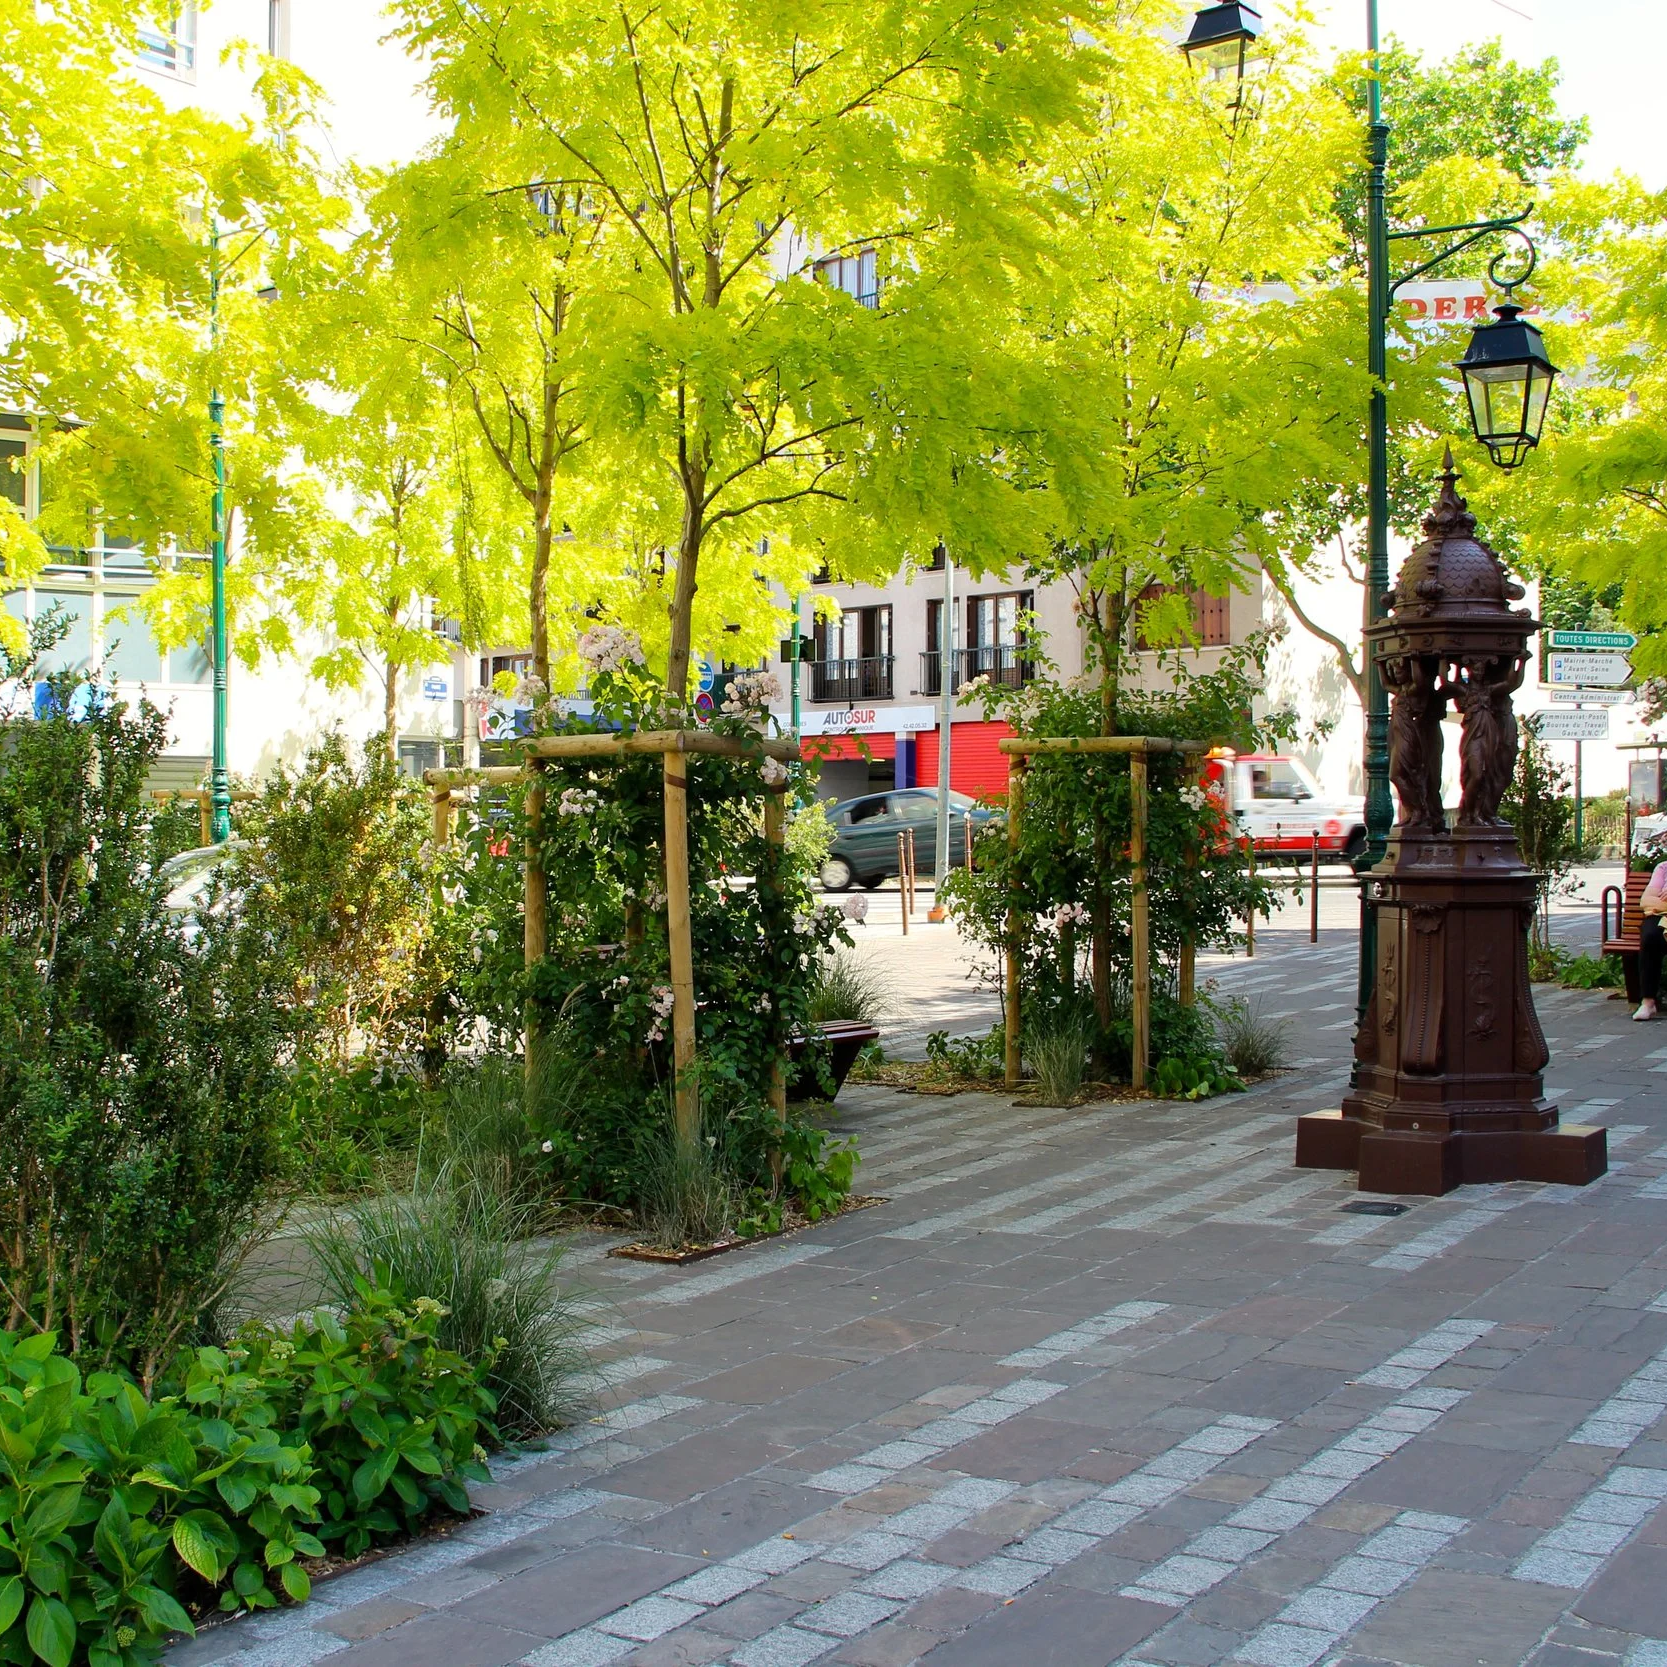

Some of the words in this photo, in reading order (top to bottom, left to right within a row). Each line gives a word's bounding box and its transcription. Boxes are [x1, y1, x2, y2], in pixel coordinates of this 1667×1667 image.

[1555, 634, 1583, 644] TOUTES
[1585, 635, 1629, 646] DIRECTIONS
[1574, 674, 1598, 682] Village
[823, 710, 876, 725] AUTOSUR
